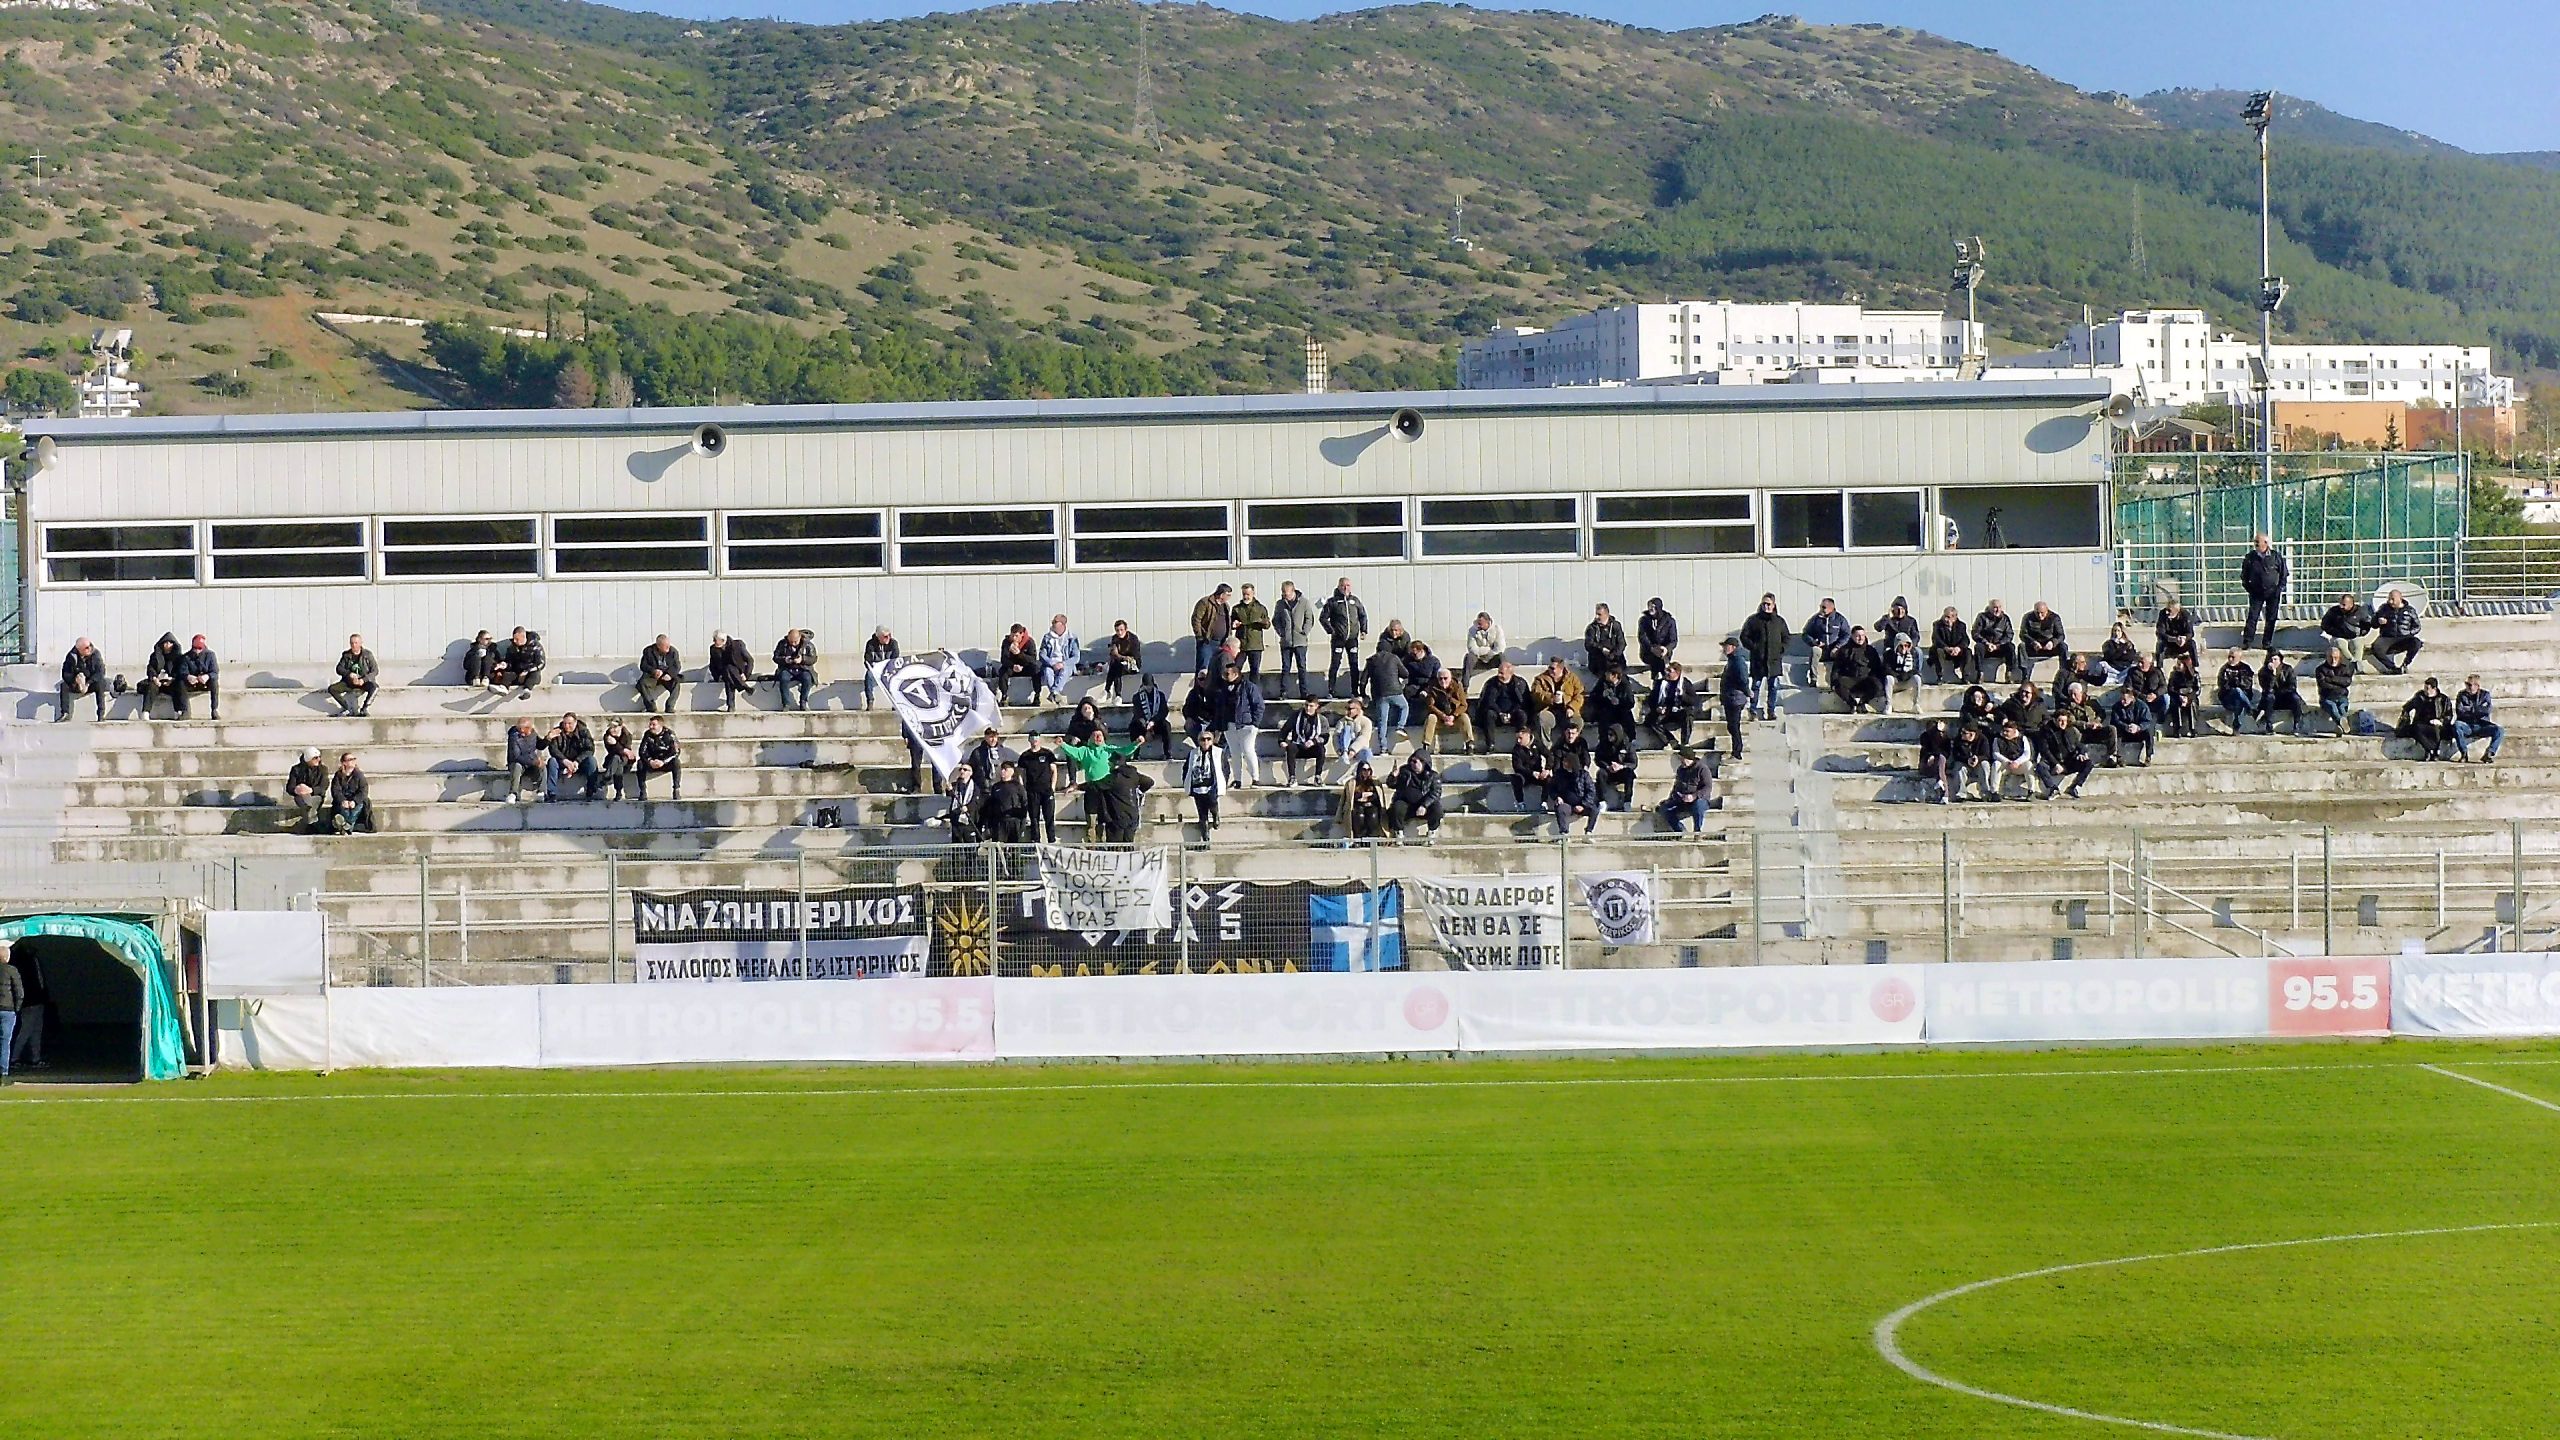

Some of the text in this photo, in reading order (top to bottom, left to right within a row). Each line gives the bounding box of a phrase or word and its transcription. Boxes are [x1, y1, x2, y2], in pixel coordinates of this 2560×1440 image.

[1041, 871, 1115, 889] ΣΤΟΥΣ
[1047, 888, 1151, 908] ΑΓΡΟΤΕΣ
[1422, 885, 1555, 906] ΤΑΣΟ ΑΔΕΡΦΕ
[641, 894, 915, 931] ΜΙΑ ΖΩΗ ΠΙΕΡΙΚΟΣ
[1220, 913, 1241, 940] 5
[1438, 915, 1542, 936] ΔΕΝ ΘΑ ΣΕ
[646, 958, 731, 980] ΣΥΛΛΟΓΟΣ
[736, 957, 813, 978] ΜΕΓΑΛΟΣ
[829, 953, 921, 977] ΙΣΤΟΡΙΚΟΣ
[1517, 945, 1561, 967] ΠΟΤΕ
[1939, 975, 2378, 1016] METROPOLIS 95.5
[889, 997, 983, 1033] 95.5
